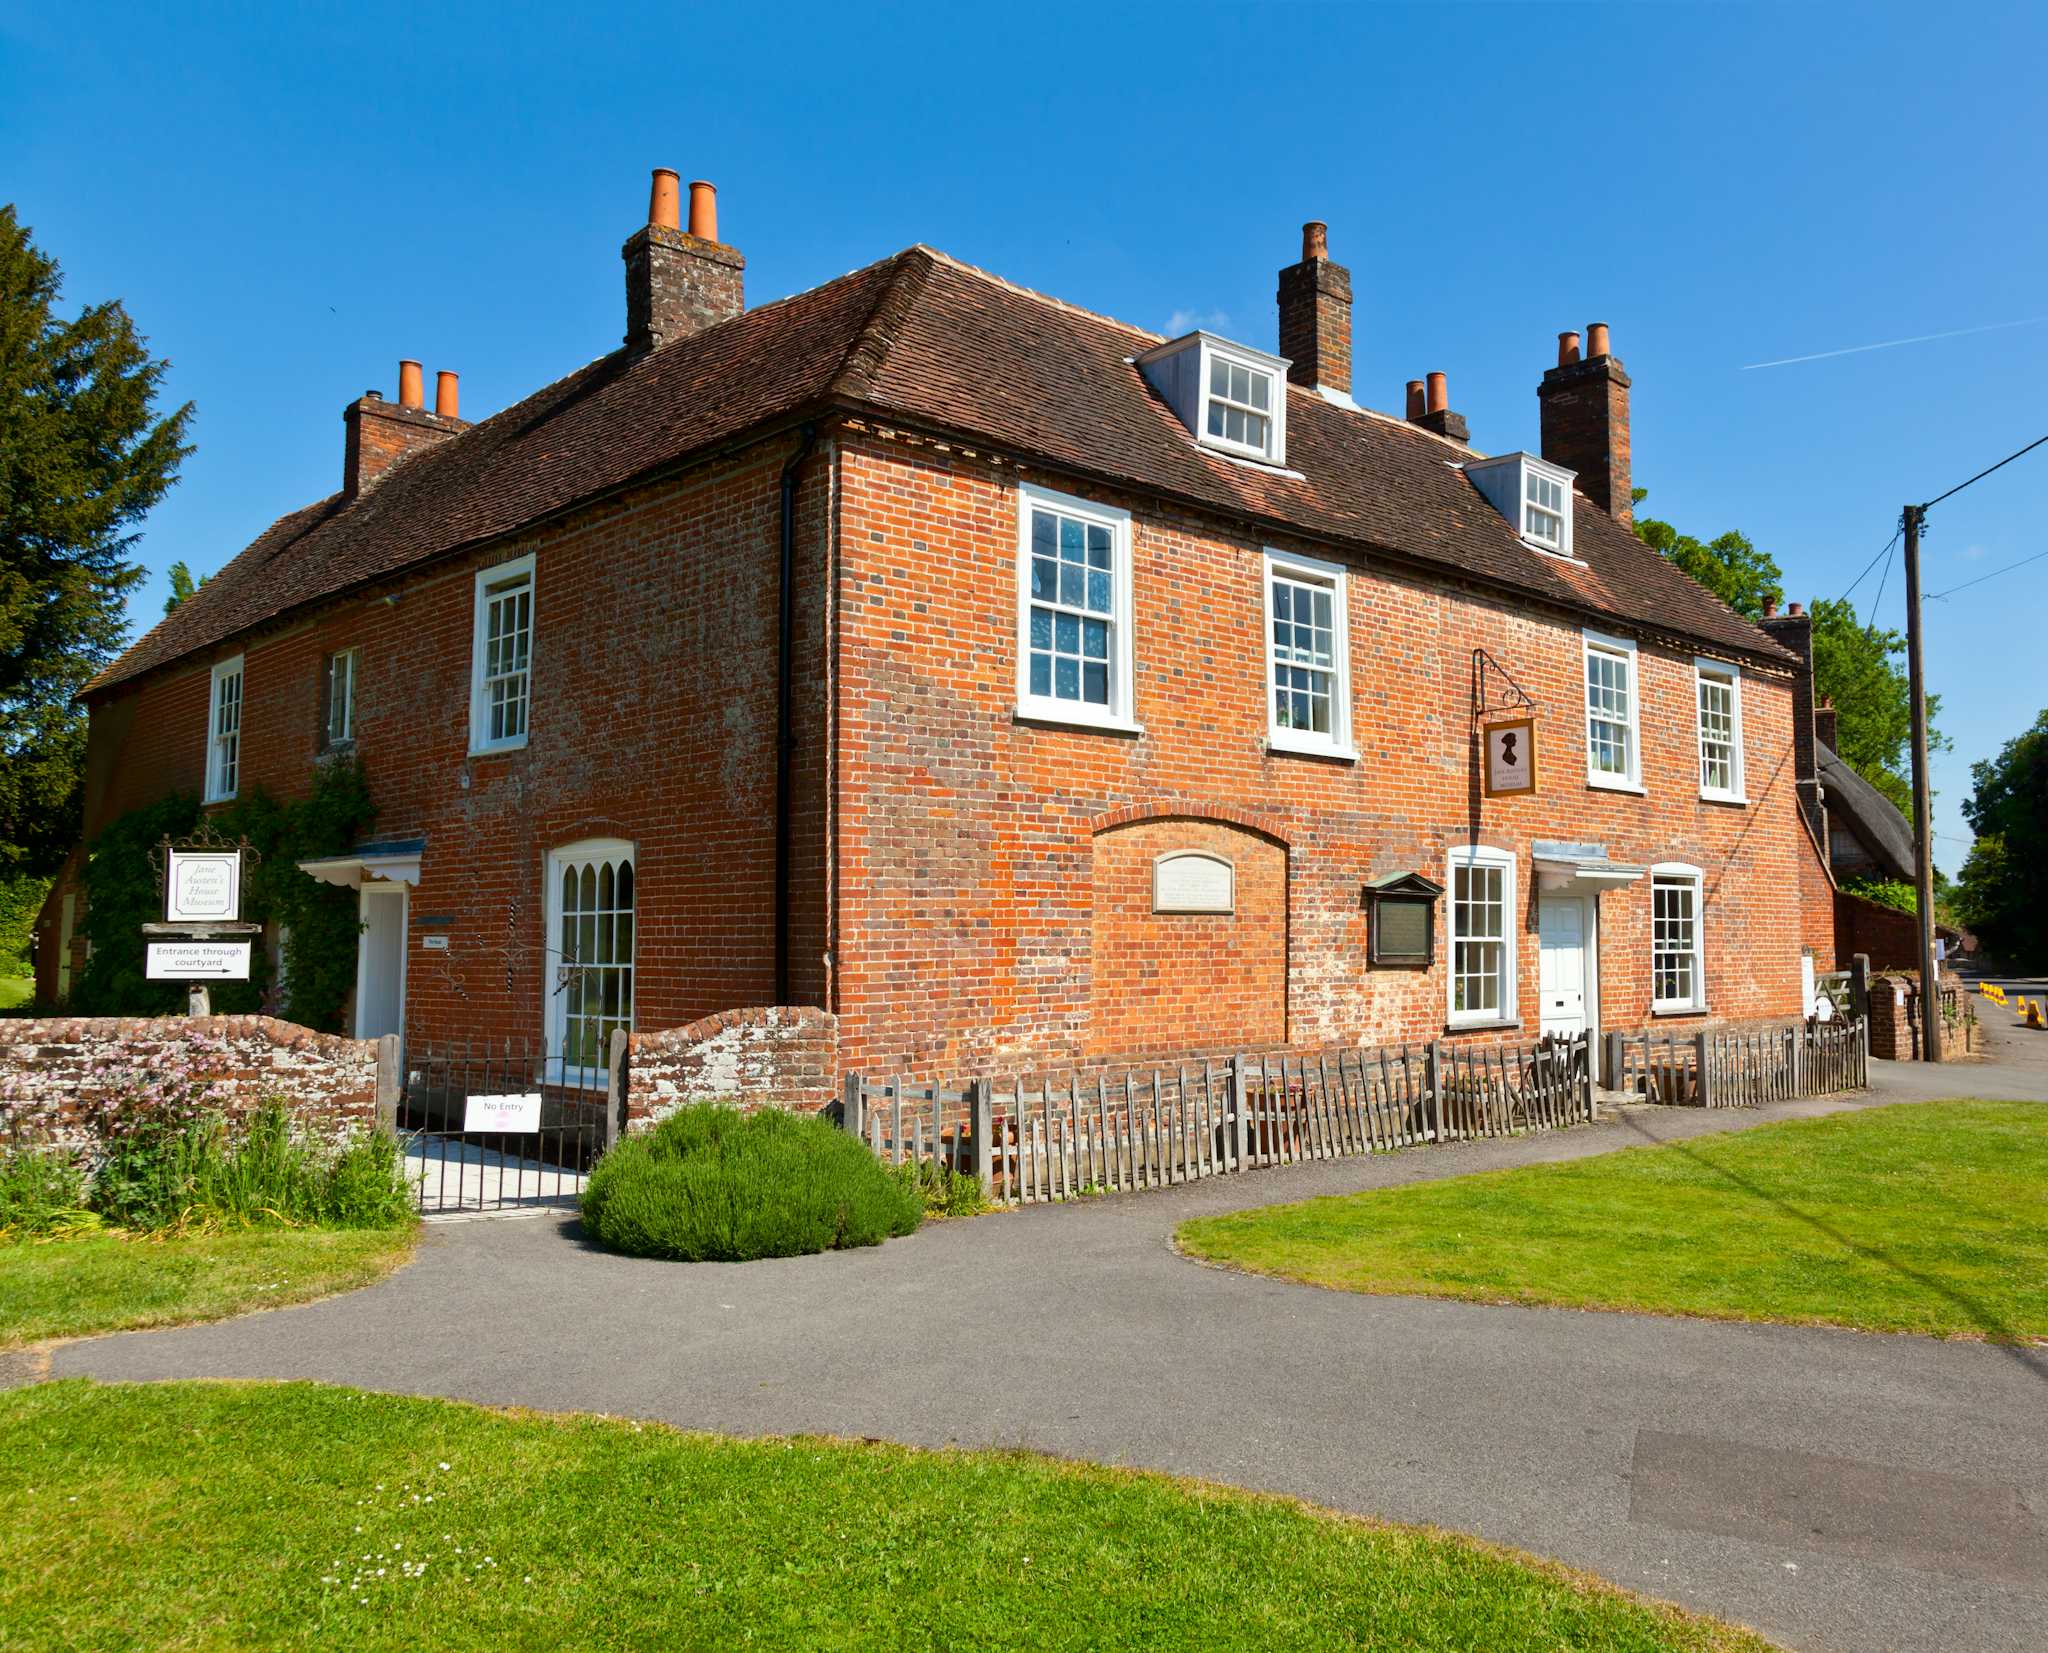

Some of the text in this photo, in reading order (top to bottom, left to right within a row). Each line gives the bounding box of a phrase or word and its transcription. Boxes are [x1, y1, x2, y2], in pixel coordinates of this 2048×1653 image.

[156, 947, 242, 957] Entrance through
[175, 959, 223, 967] courtyard
[484, 1102, 523, 1111] No Entry
